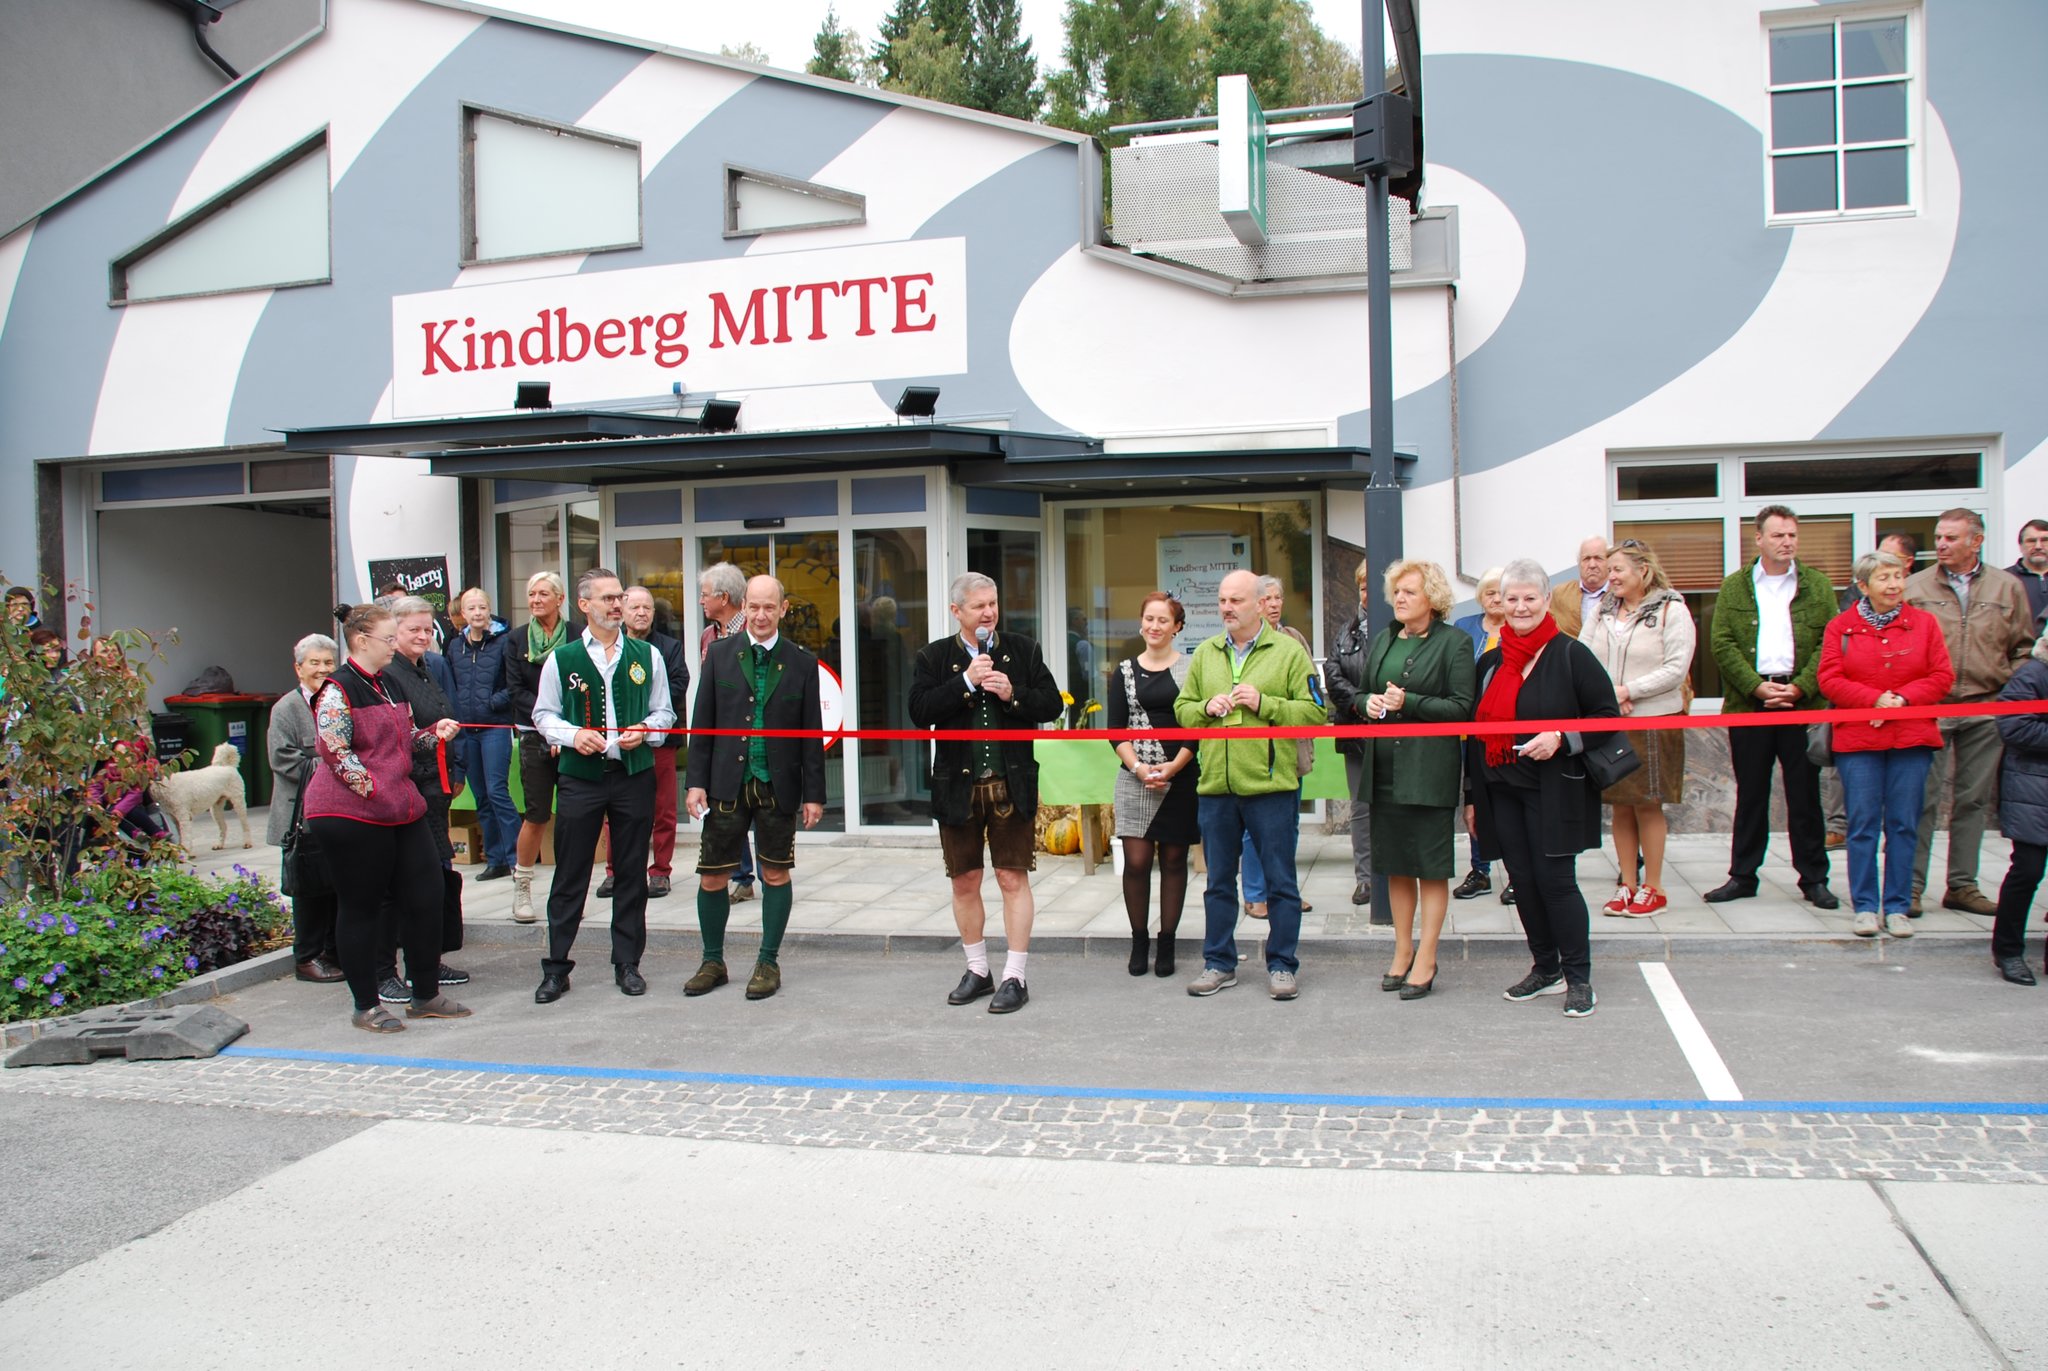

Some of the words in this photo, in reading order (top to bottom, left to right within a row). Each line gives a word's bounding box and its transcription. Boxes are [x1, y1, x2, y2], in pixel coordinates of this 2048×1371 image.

[422, 307, 688, 376] Kindberg
[709, 273, 936, 349] MITTE
[1169, 564, 1208, 573] Kindberg
[1210, 562, 1239, 571] MITTE
